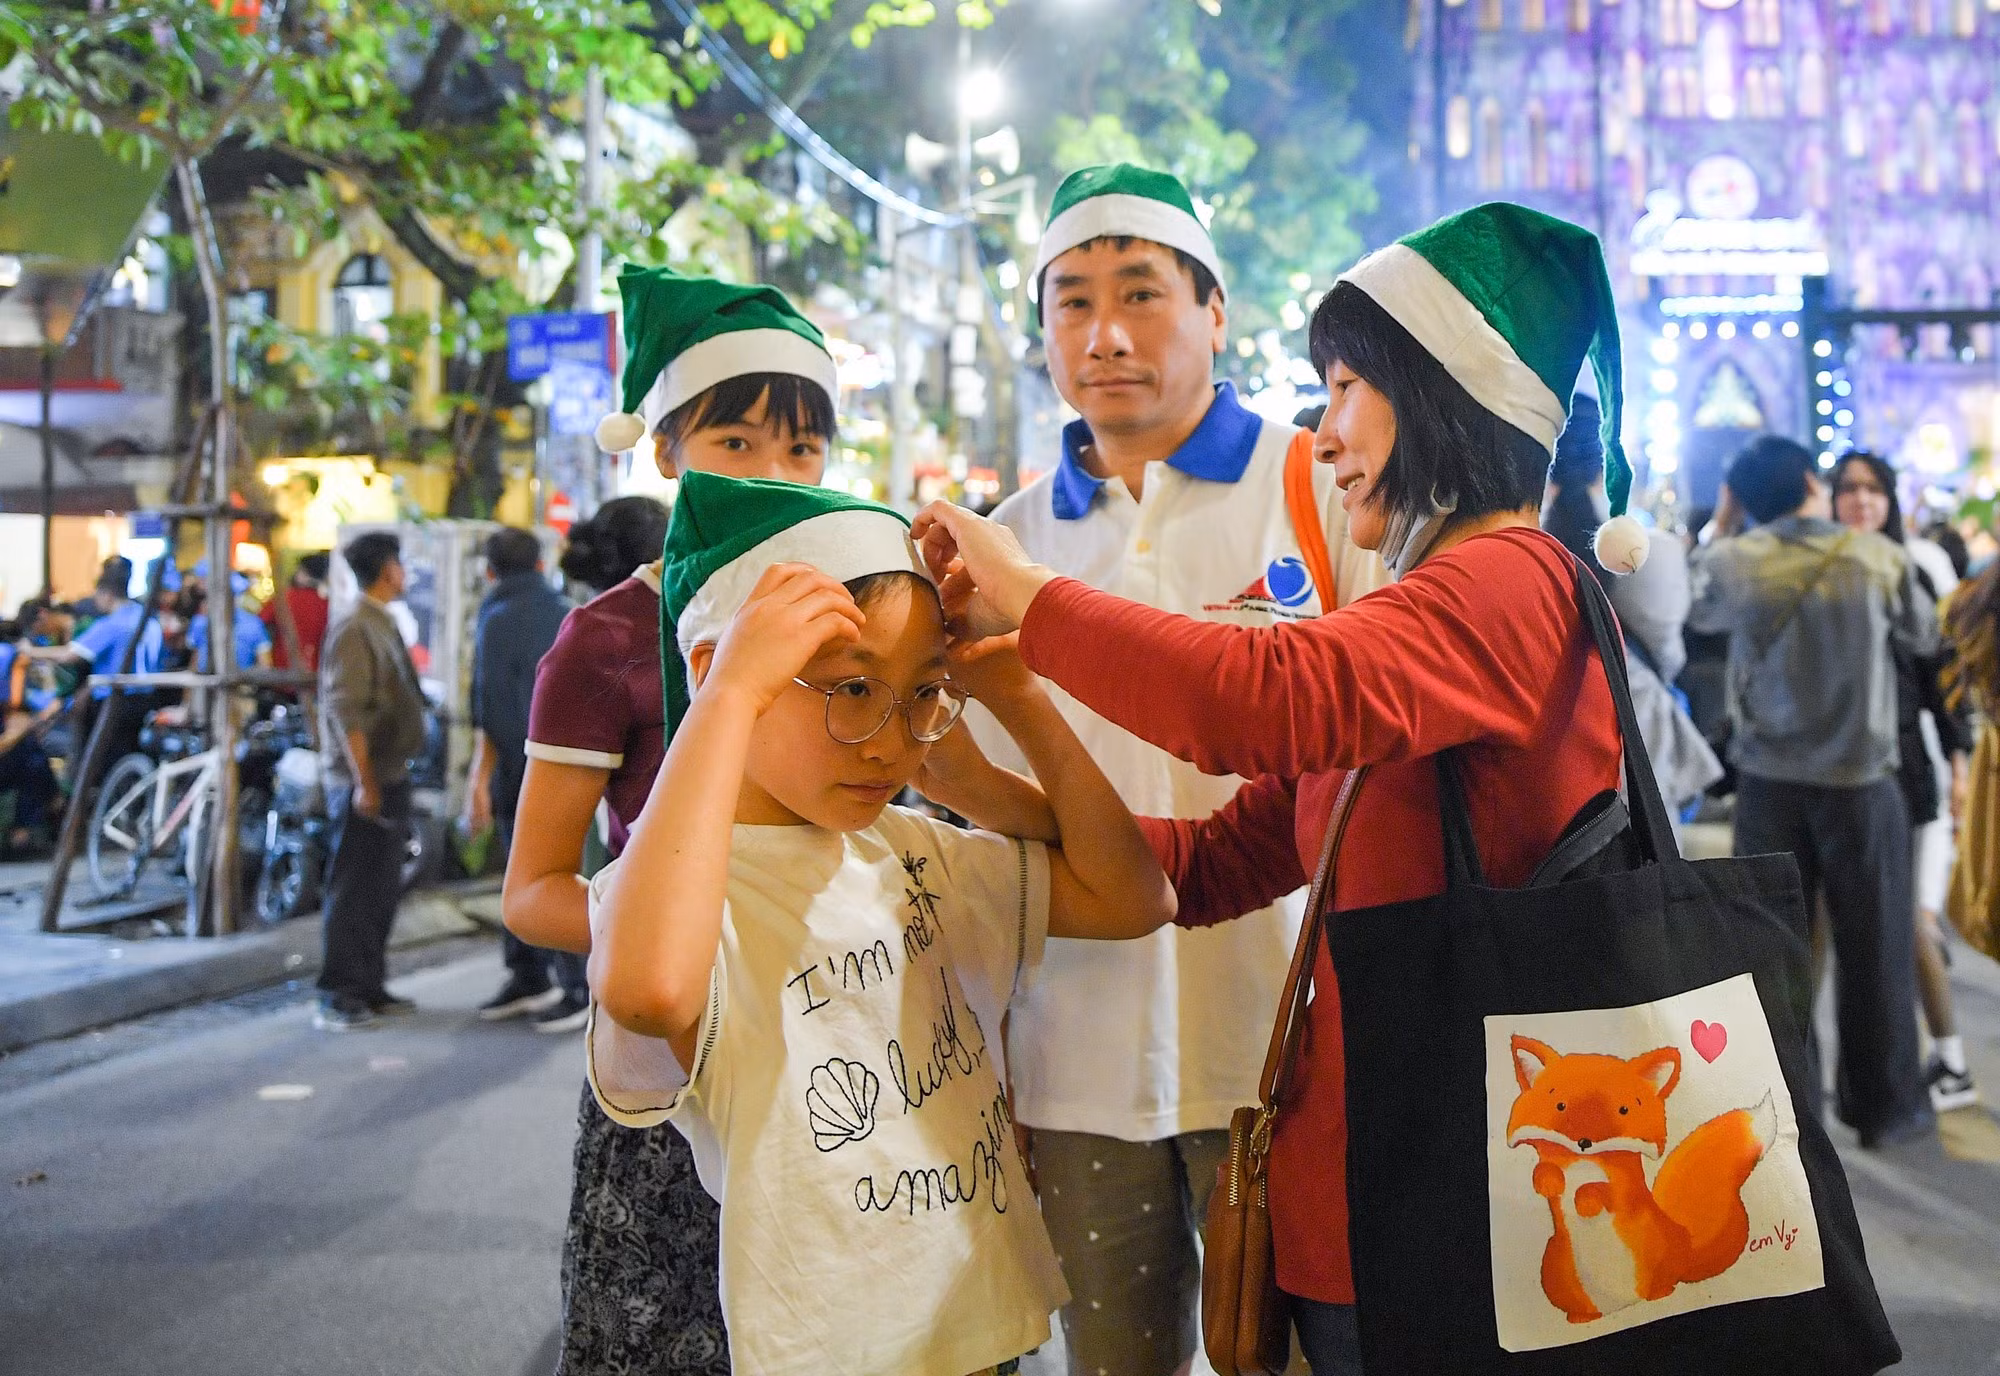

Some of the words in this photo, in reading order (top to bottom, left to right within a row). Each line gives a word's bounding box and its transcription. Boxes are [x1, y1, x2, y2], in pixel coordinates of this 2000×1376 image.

[787, 939, 893, 1016] I'm
[854, 1081, 1011, 1214] amazin
[1749, 1235, 1773, 1252] em
